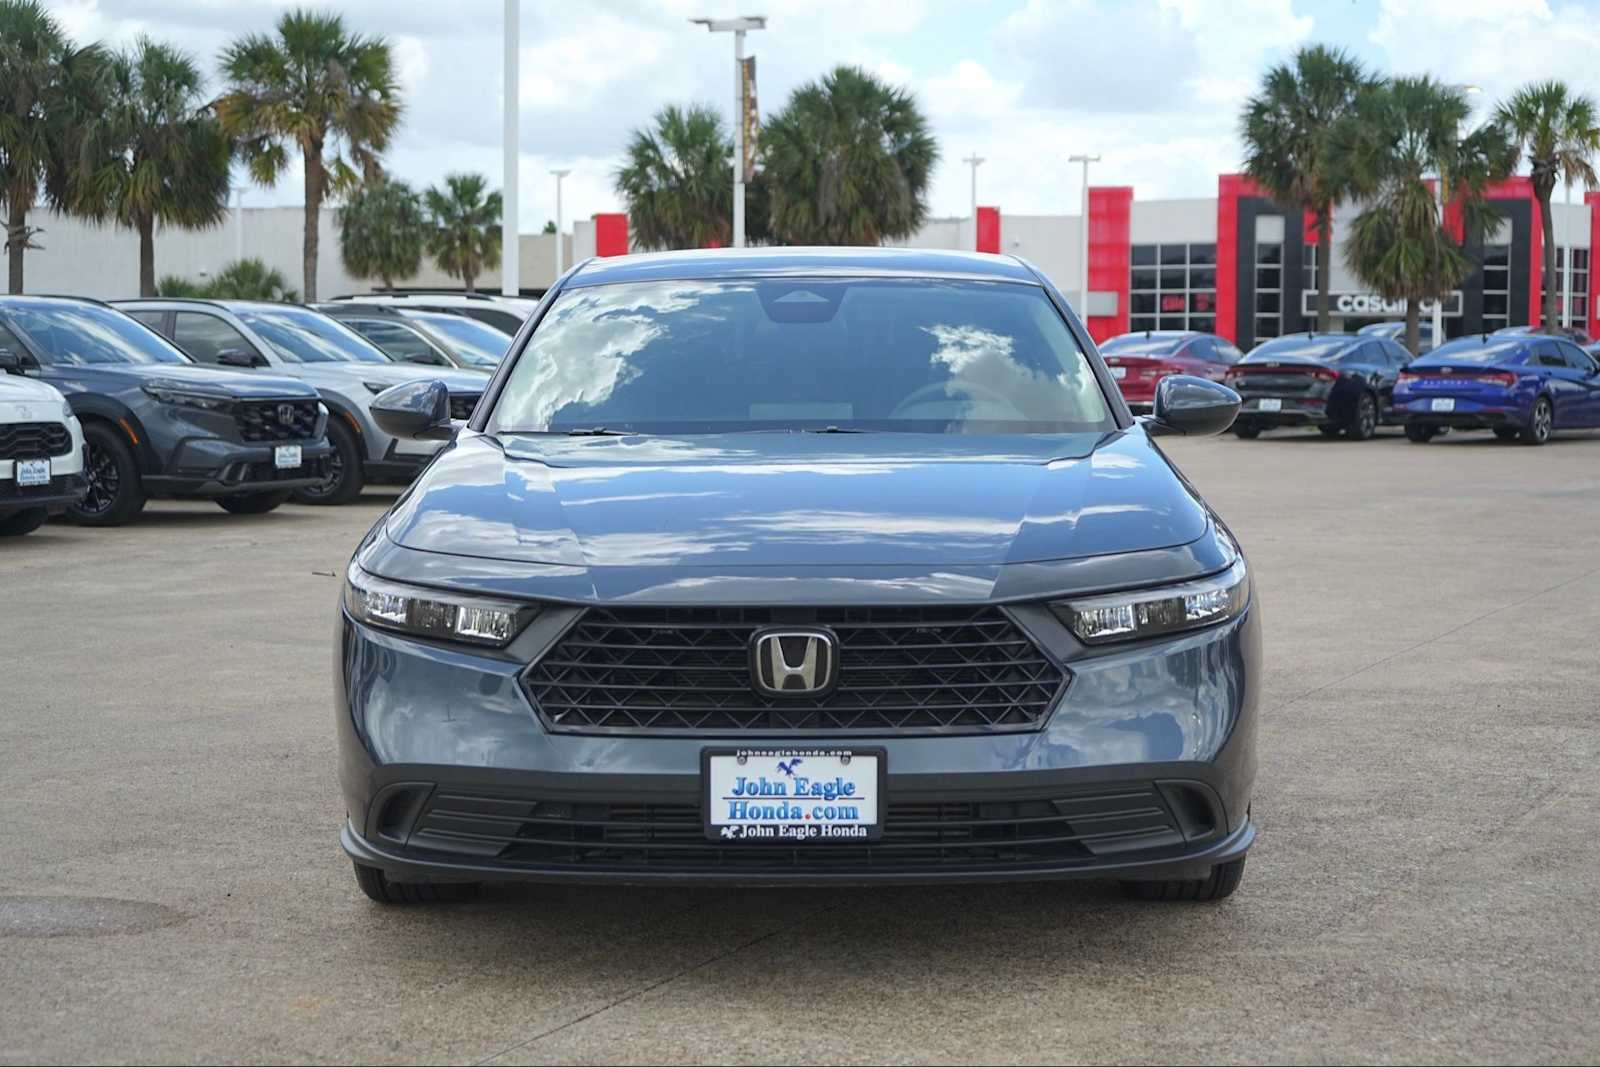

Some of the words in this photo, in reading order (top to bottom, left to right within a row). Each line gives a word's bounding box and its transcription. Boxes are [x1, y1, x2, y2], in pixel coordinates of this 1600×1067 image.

[732, 777, 787, 796] John
[793, 777, 856, 801] Eagle
[728, 800, 859, 820] Honda.com
[739, 825, 775, 838] John
[778, 825, 817, 840] Eagle
[821, 825, 867, 837] Honda
